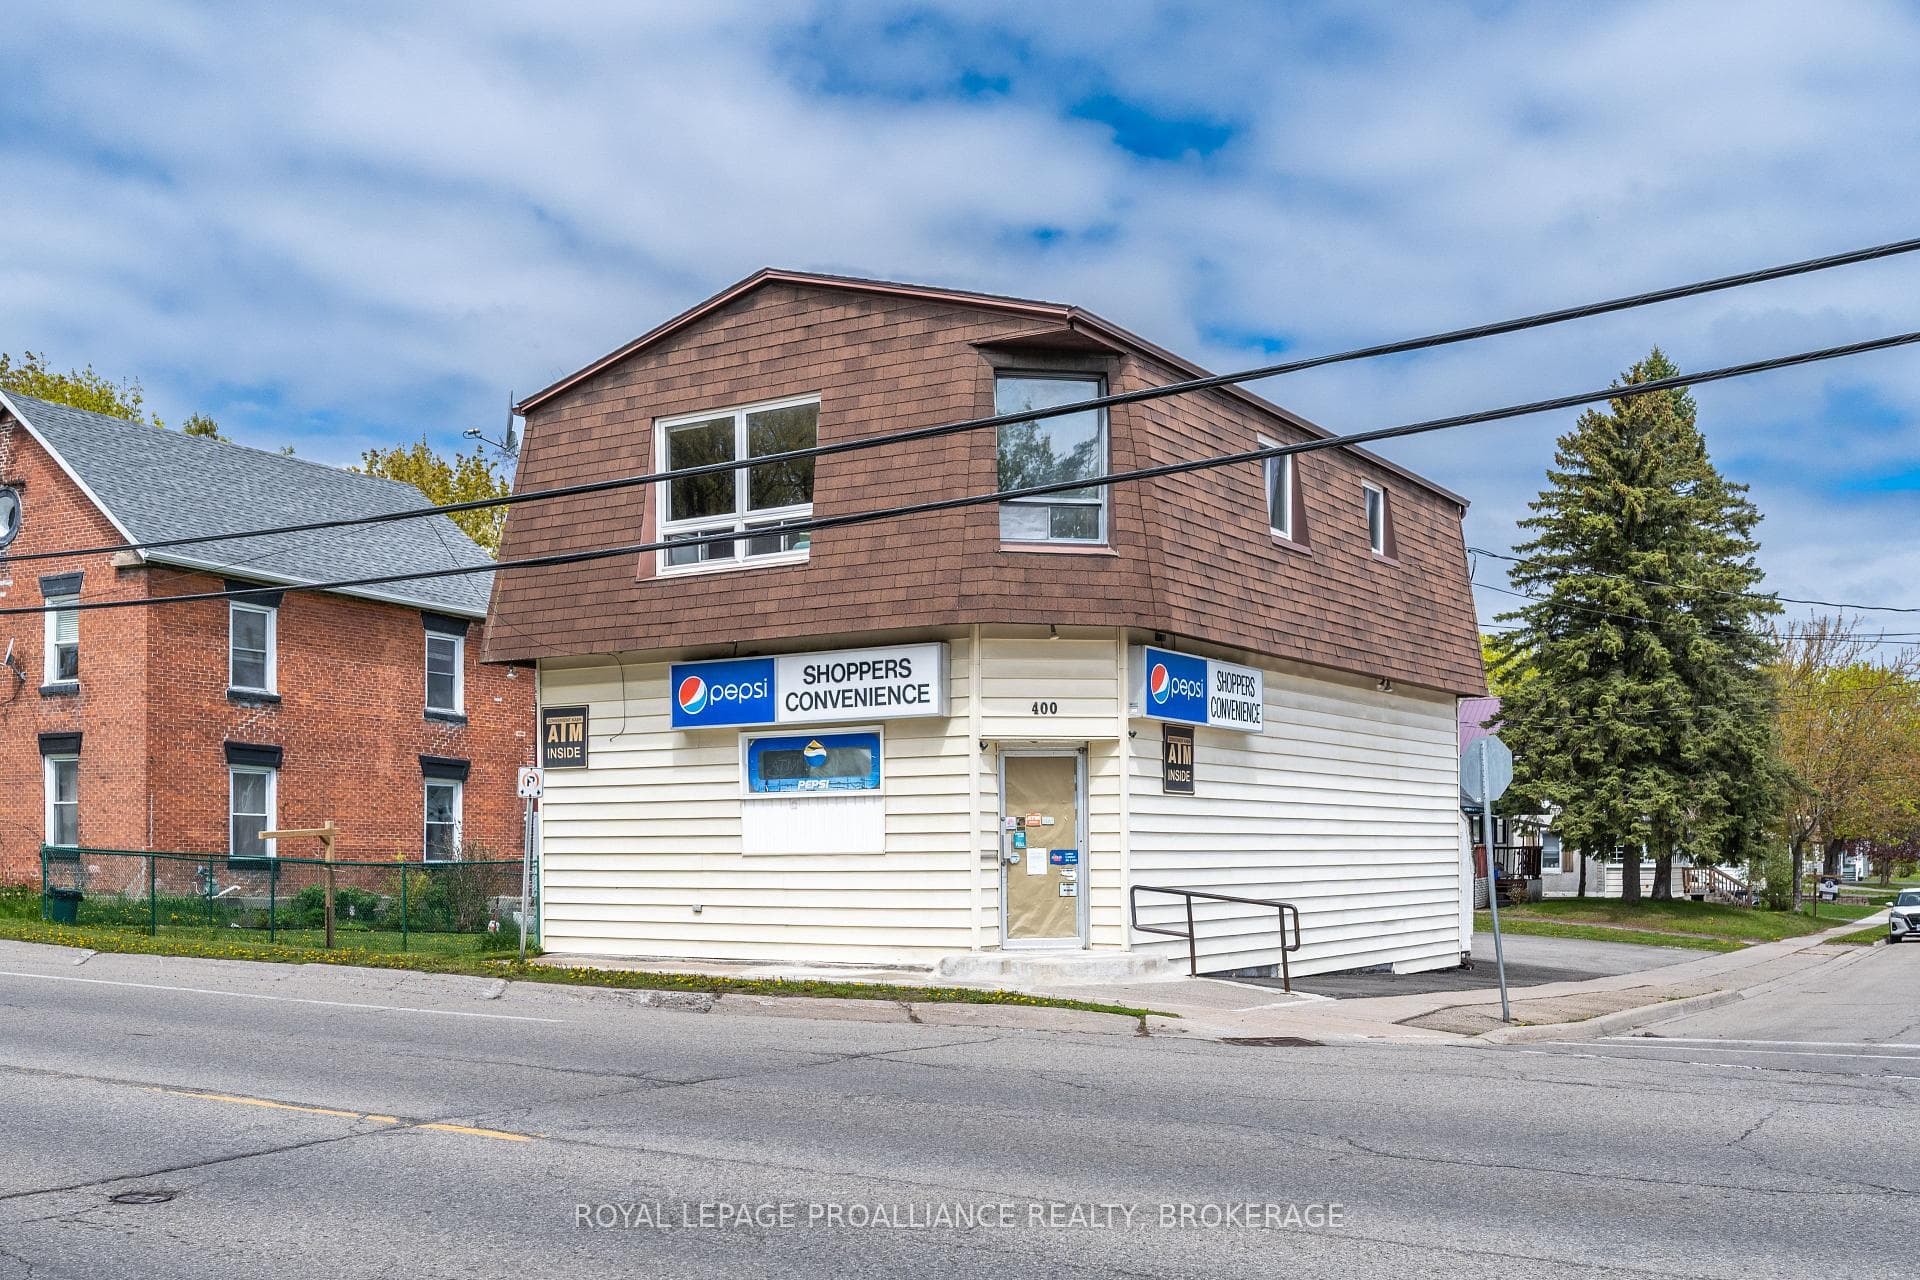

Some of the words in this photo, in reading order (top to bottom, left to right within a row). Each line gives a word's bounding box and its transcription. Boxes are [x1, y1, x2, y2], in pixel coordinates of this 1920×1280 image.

[803, 657, 912, 685] SHOPPERS
[1216, 670, 1255, 698] SHOPPERS
[710, 678, 768, 705] pepsi
[785, 683, 930, 712] CONVENIENCE
[1171, 677, 1204, 701] pepsi
[1031, 701, 1058, 715] 400
[1210, 696, 1261, 724] CONVENIENCE
[547, 718, 583, 743] ATM
[547, 746, 581, 759] INSIDE
[1168, 738, 1192, 765] ATM
[798, 779, 830, 790] PEPSI
[1167, 769, 1191, 782] INSIDE
